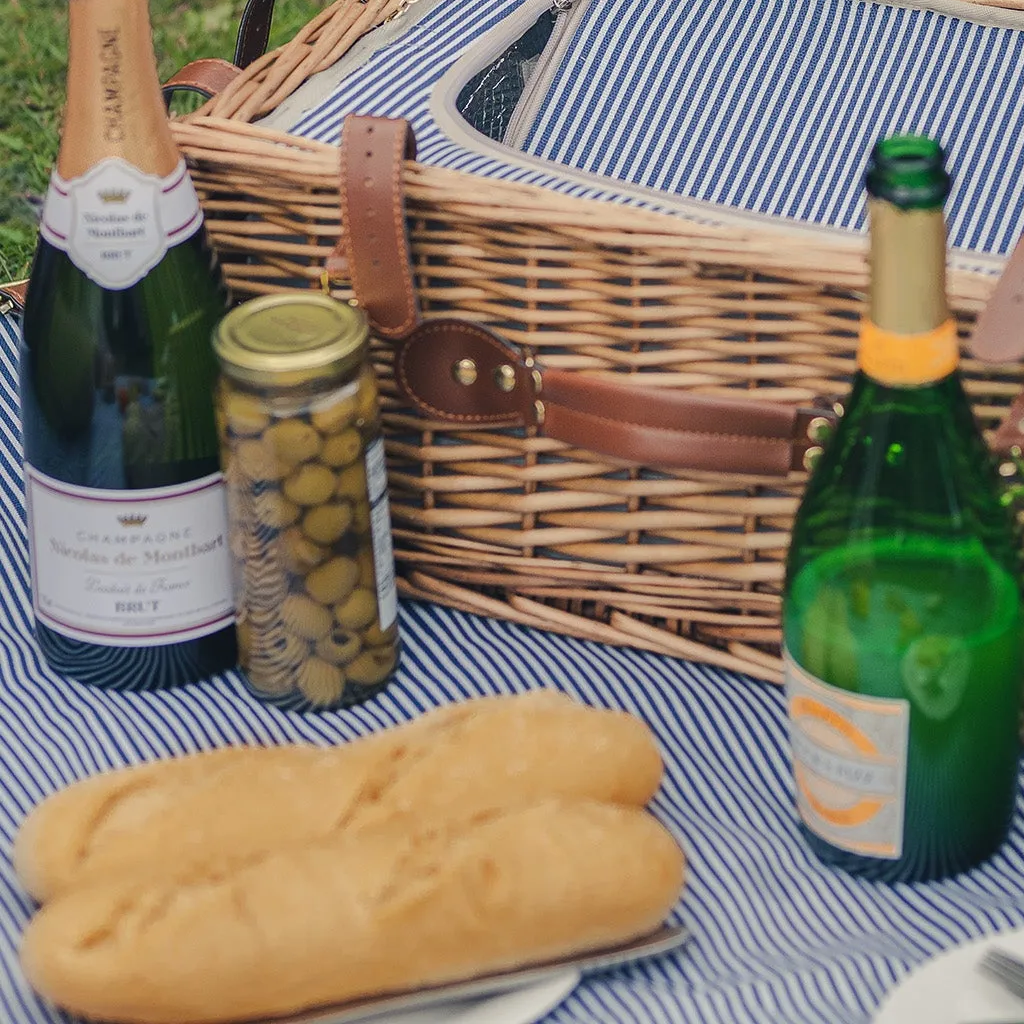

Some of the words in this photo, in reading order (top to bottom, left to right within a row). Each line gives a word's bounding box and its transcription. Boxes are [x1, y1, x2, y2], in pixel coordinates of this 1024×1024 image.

[98, 27, 125, 142] CHAMPAGNE
[76, 527, 194, 545] CHAMPAGNE
[115, 600, 161, 614] BRUT
